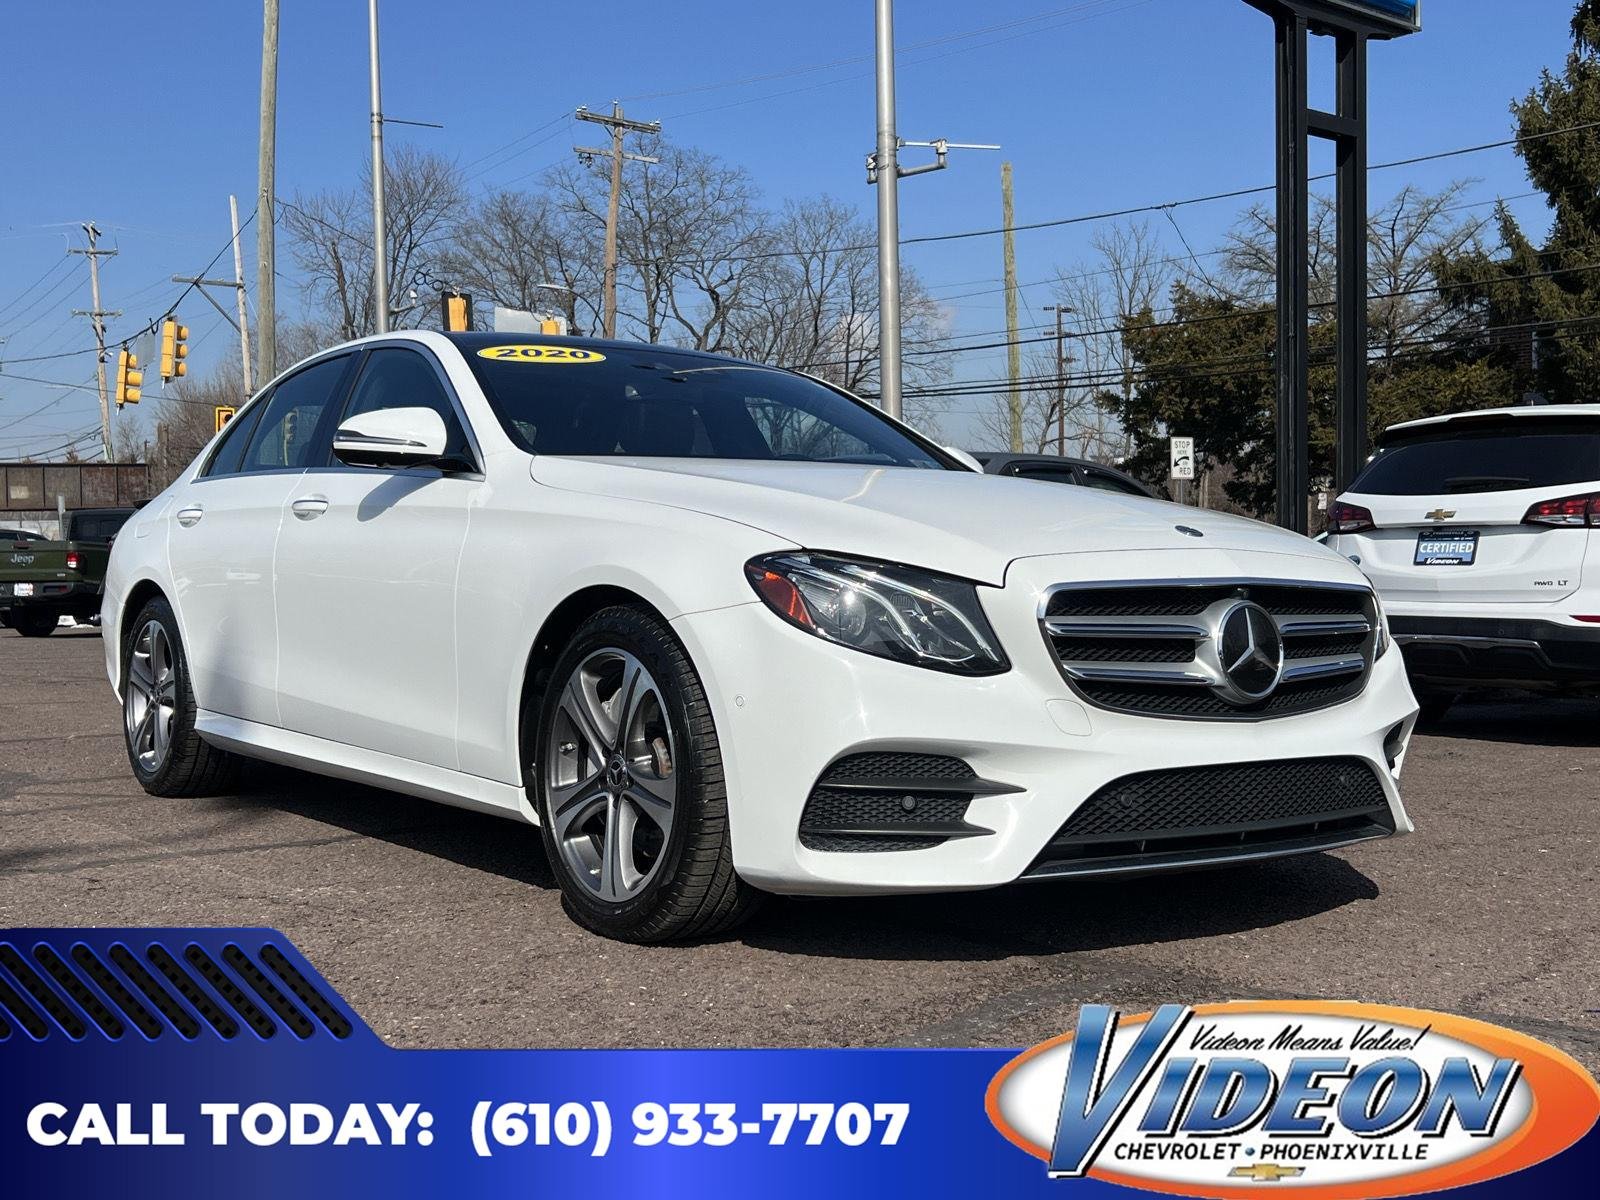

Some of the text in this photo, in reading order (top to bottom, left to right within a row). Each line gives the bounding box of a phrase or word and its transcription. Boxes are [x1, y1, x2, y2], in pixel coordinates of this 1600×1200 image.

[496, 348, 590, 359] 2020
[1174, 441, 1190, 449] STOP
[1179, 467, 1192, 475] RED
[1420, 542, 1474, 553] CERTIFIED
[10, 553, 35, 564] Jeep
